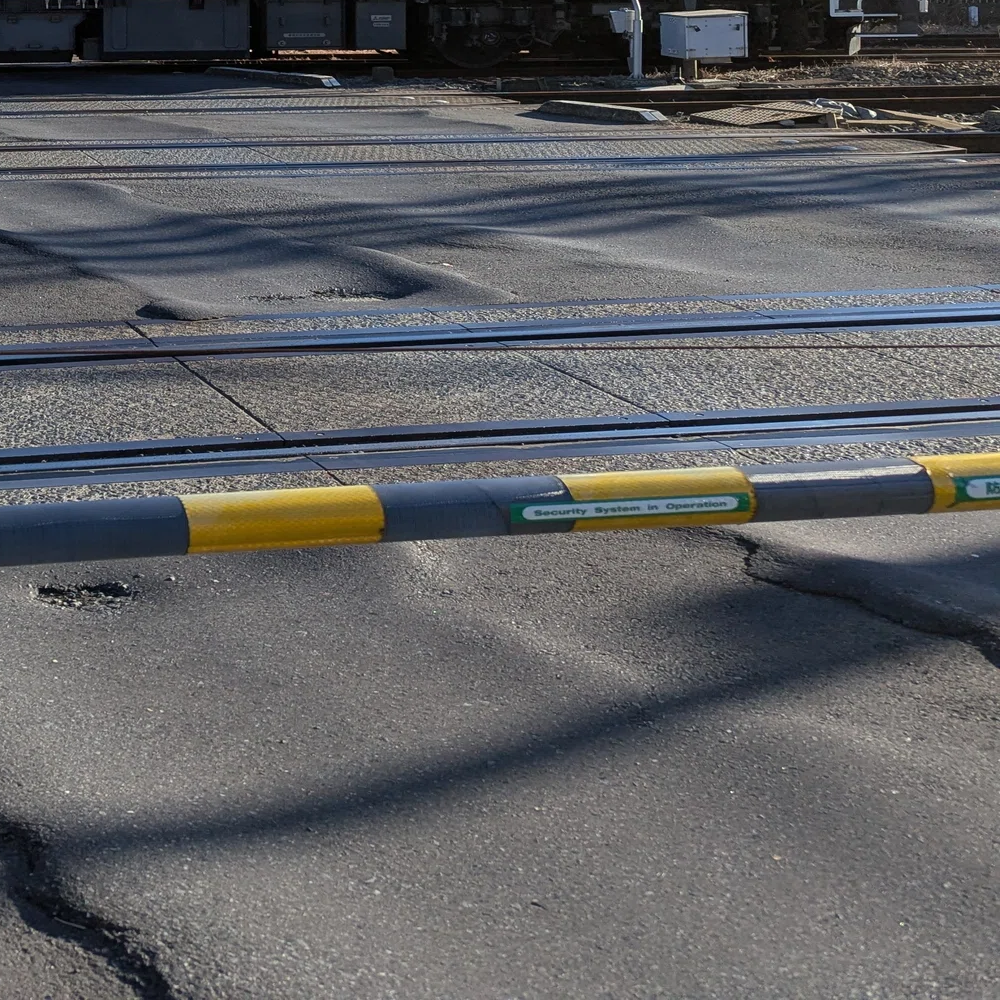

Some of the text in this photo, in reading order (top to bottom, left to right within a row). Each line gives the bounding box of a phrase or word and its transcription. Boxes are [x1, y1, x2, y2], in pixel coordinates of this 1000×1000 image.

[534, 500, 728, 517] Security System in Operation
